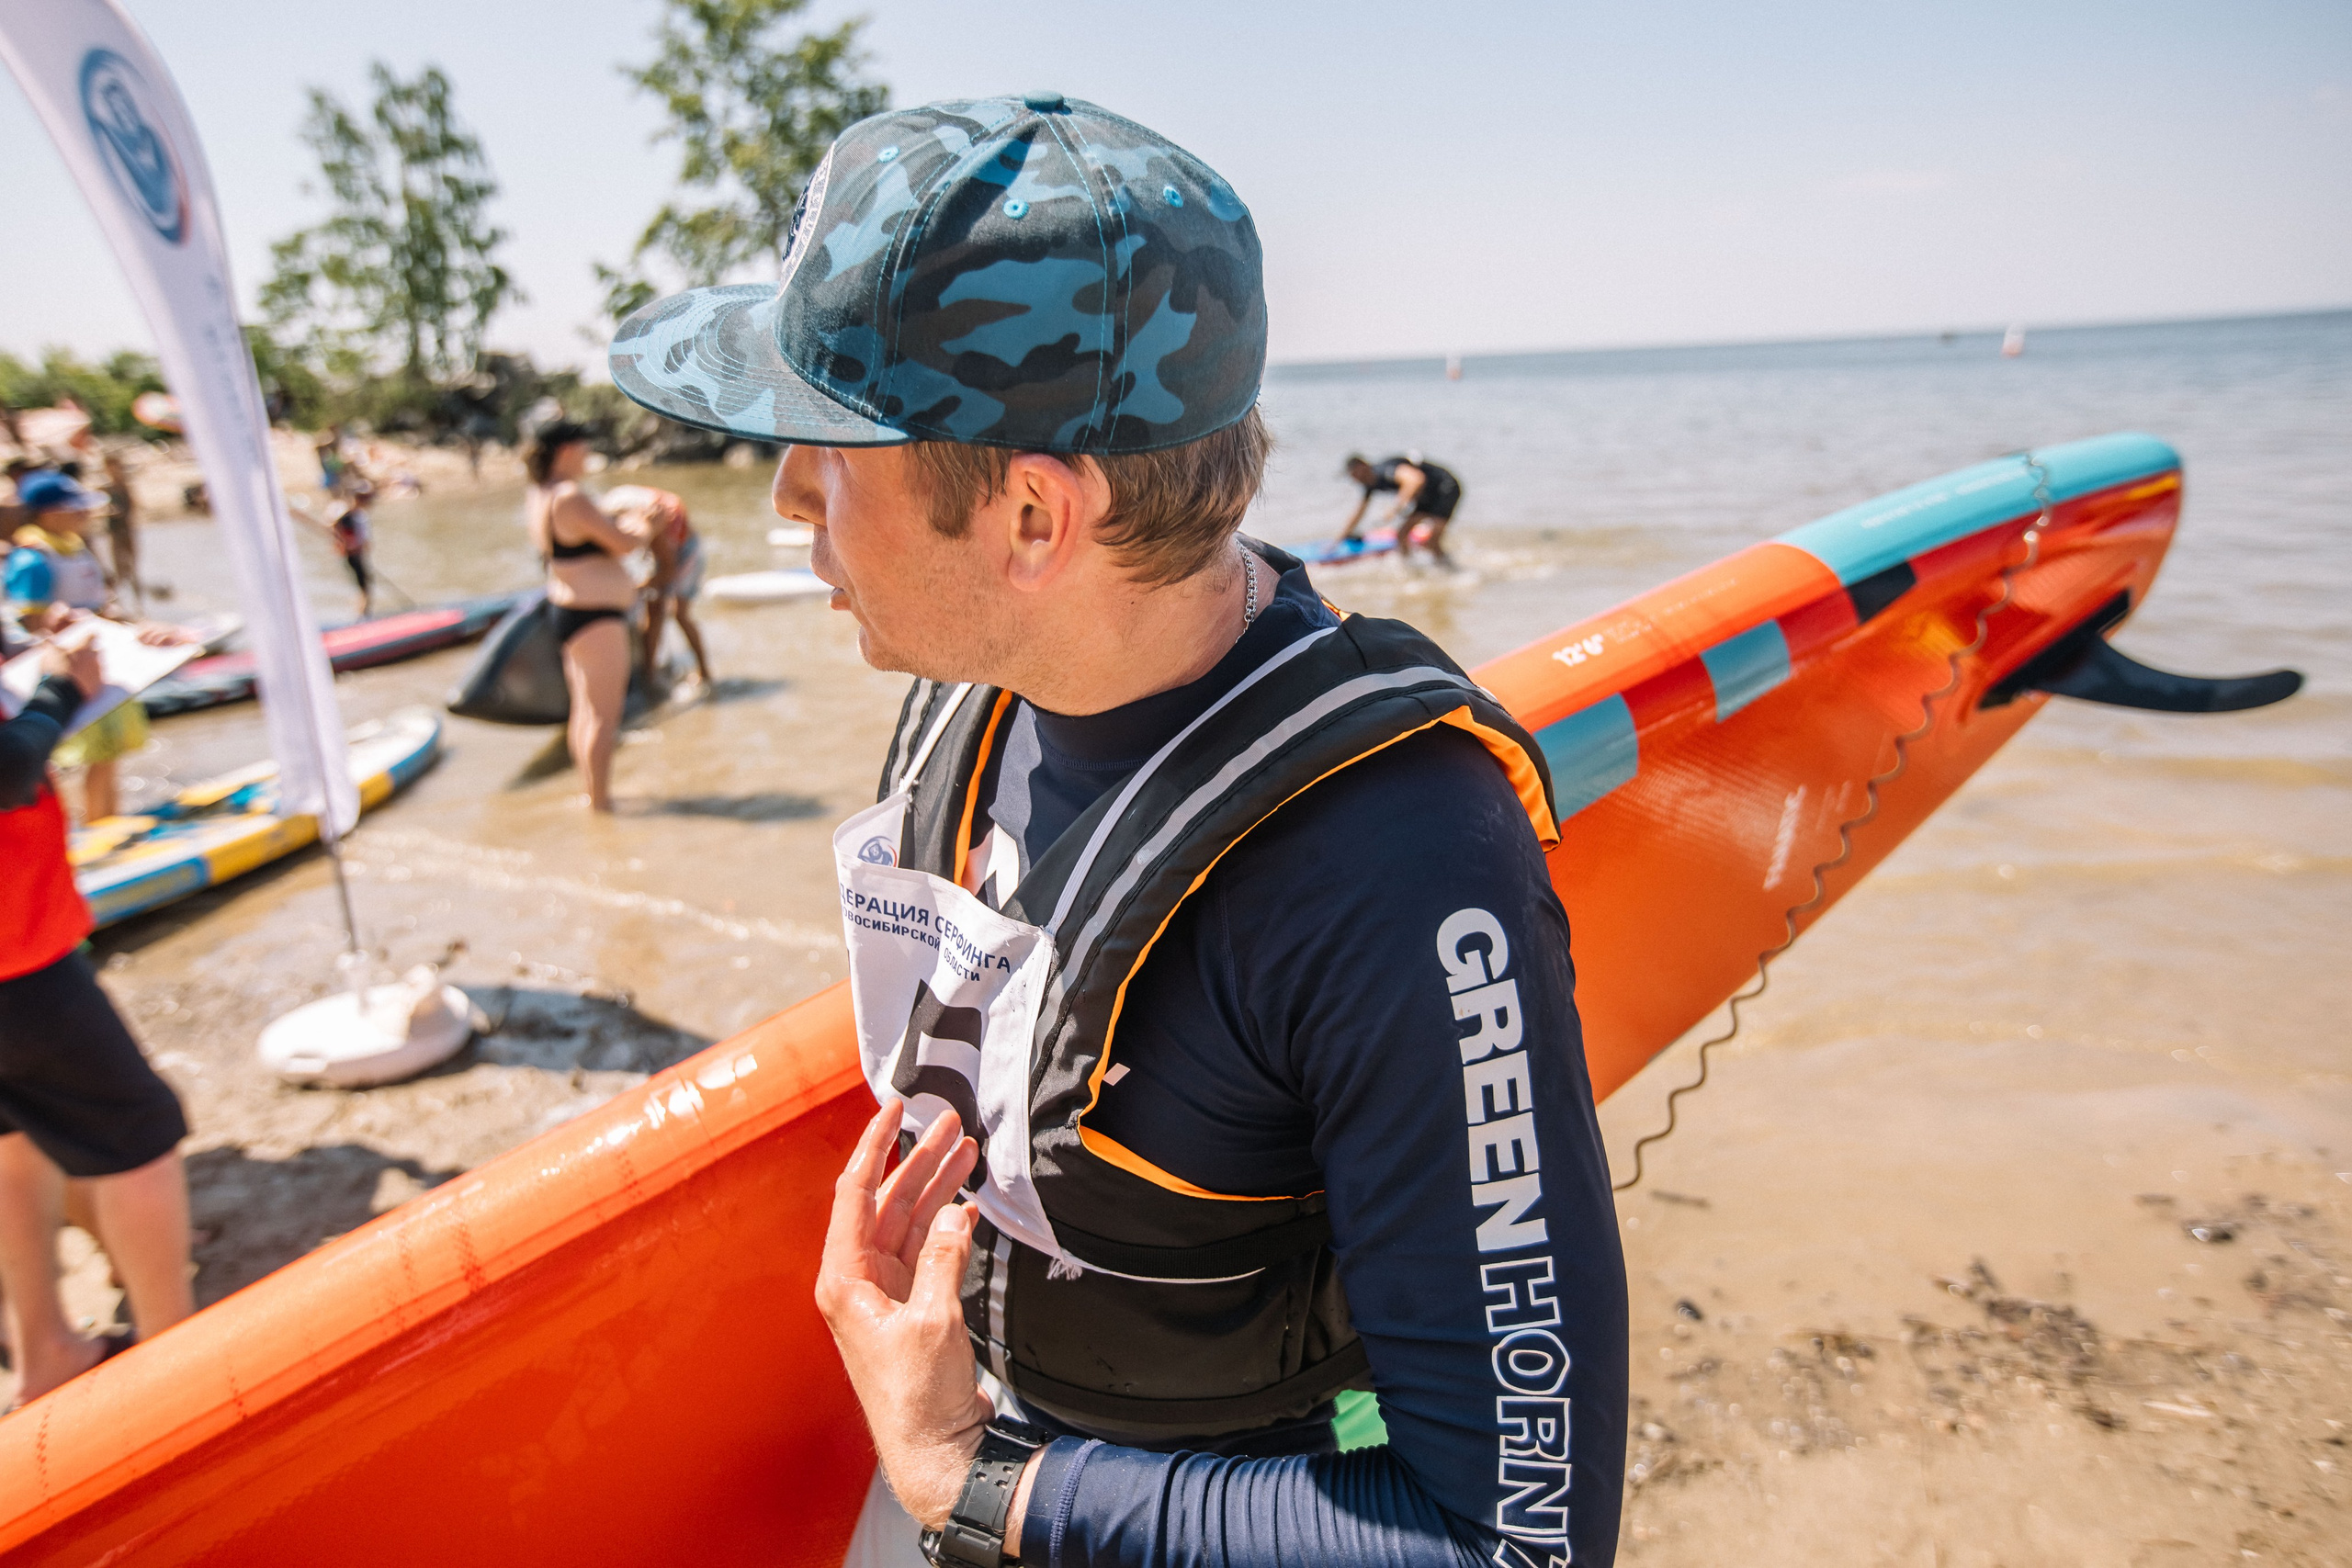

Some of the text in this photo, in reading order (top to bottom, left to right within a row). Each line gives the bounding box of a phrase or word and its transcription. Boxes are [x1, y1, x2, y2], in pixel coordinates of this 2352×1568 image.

[935, 916, 1011, 974] СЕРФИНГА
[944, 947, 980, 982] ОБЛАСТИ
[890, 978, 989, 1194] 5
